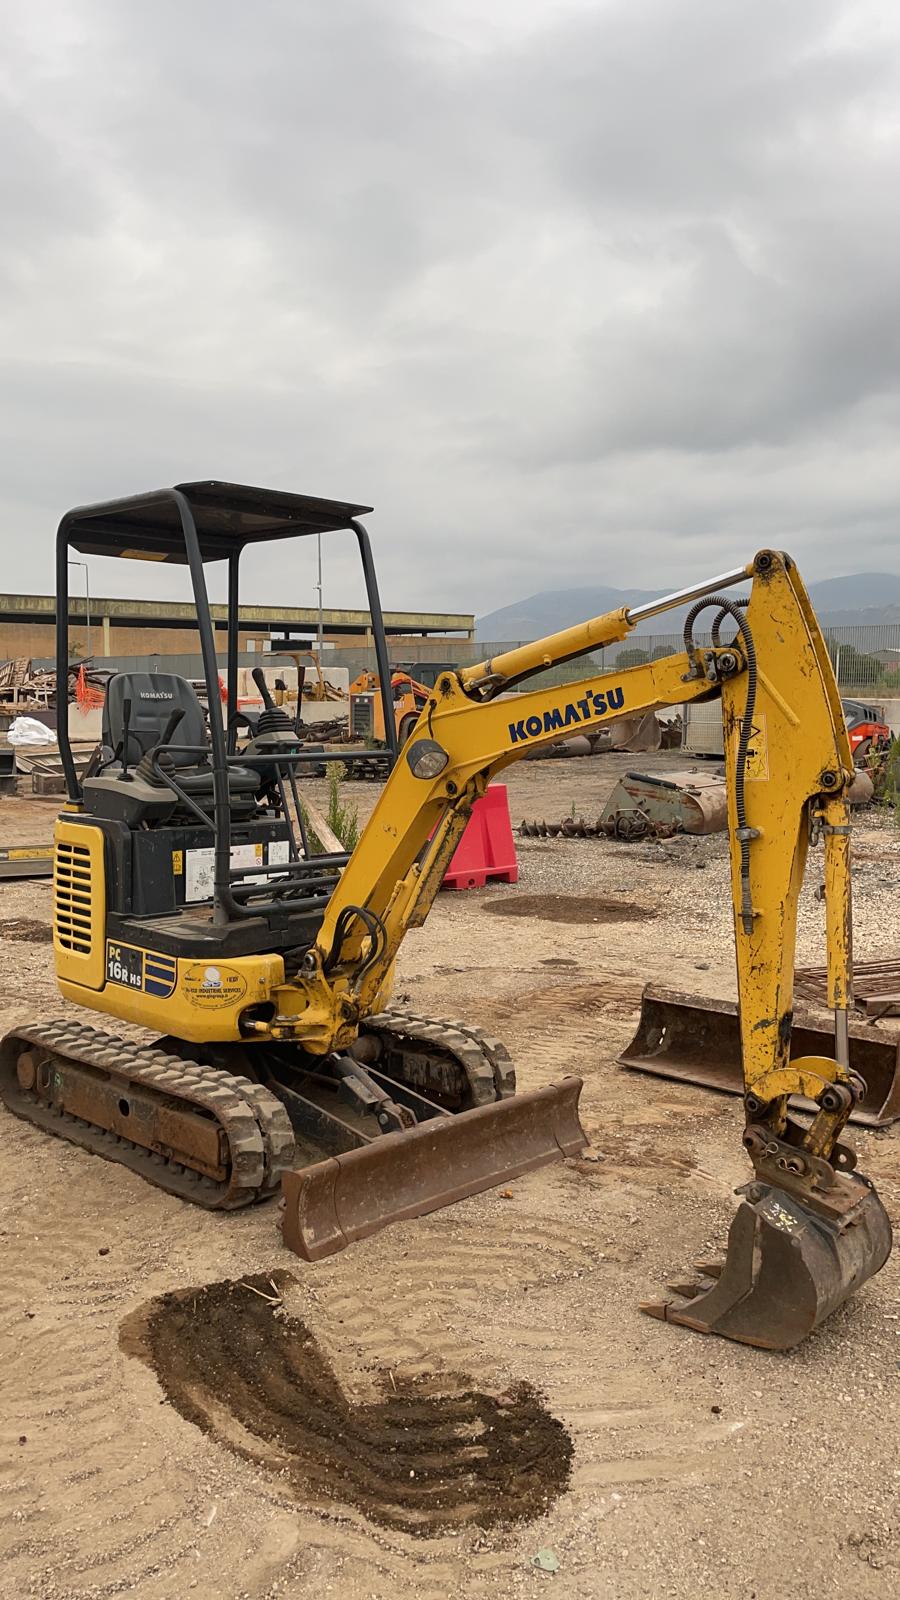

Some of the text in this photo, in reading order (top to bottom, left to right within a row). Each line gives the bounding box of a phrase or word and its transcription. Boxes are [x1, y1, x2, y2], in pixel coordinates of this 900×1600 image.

[140, 691, 173, 699] KOMATSU
[508, 687, 624, 743] KOMATSU
[109, 946, 121, 961] PC
